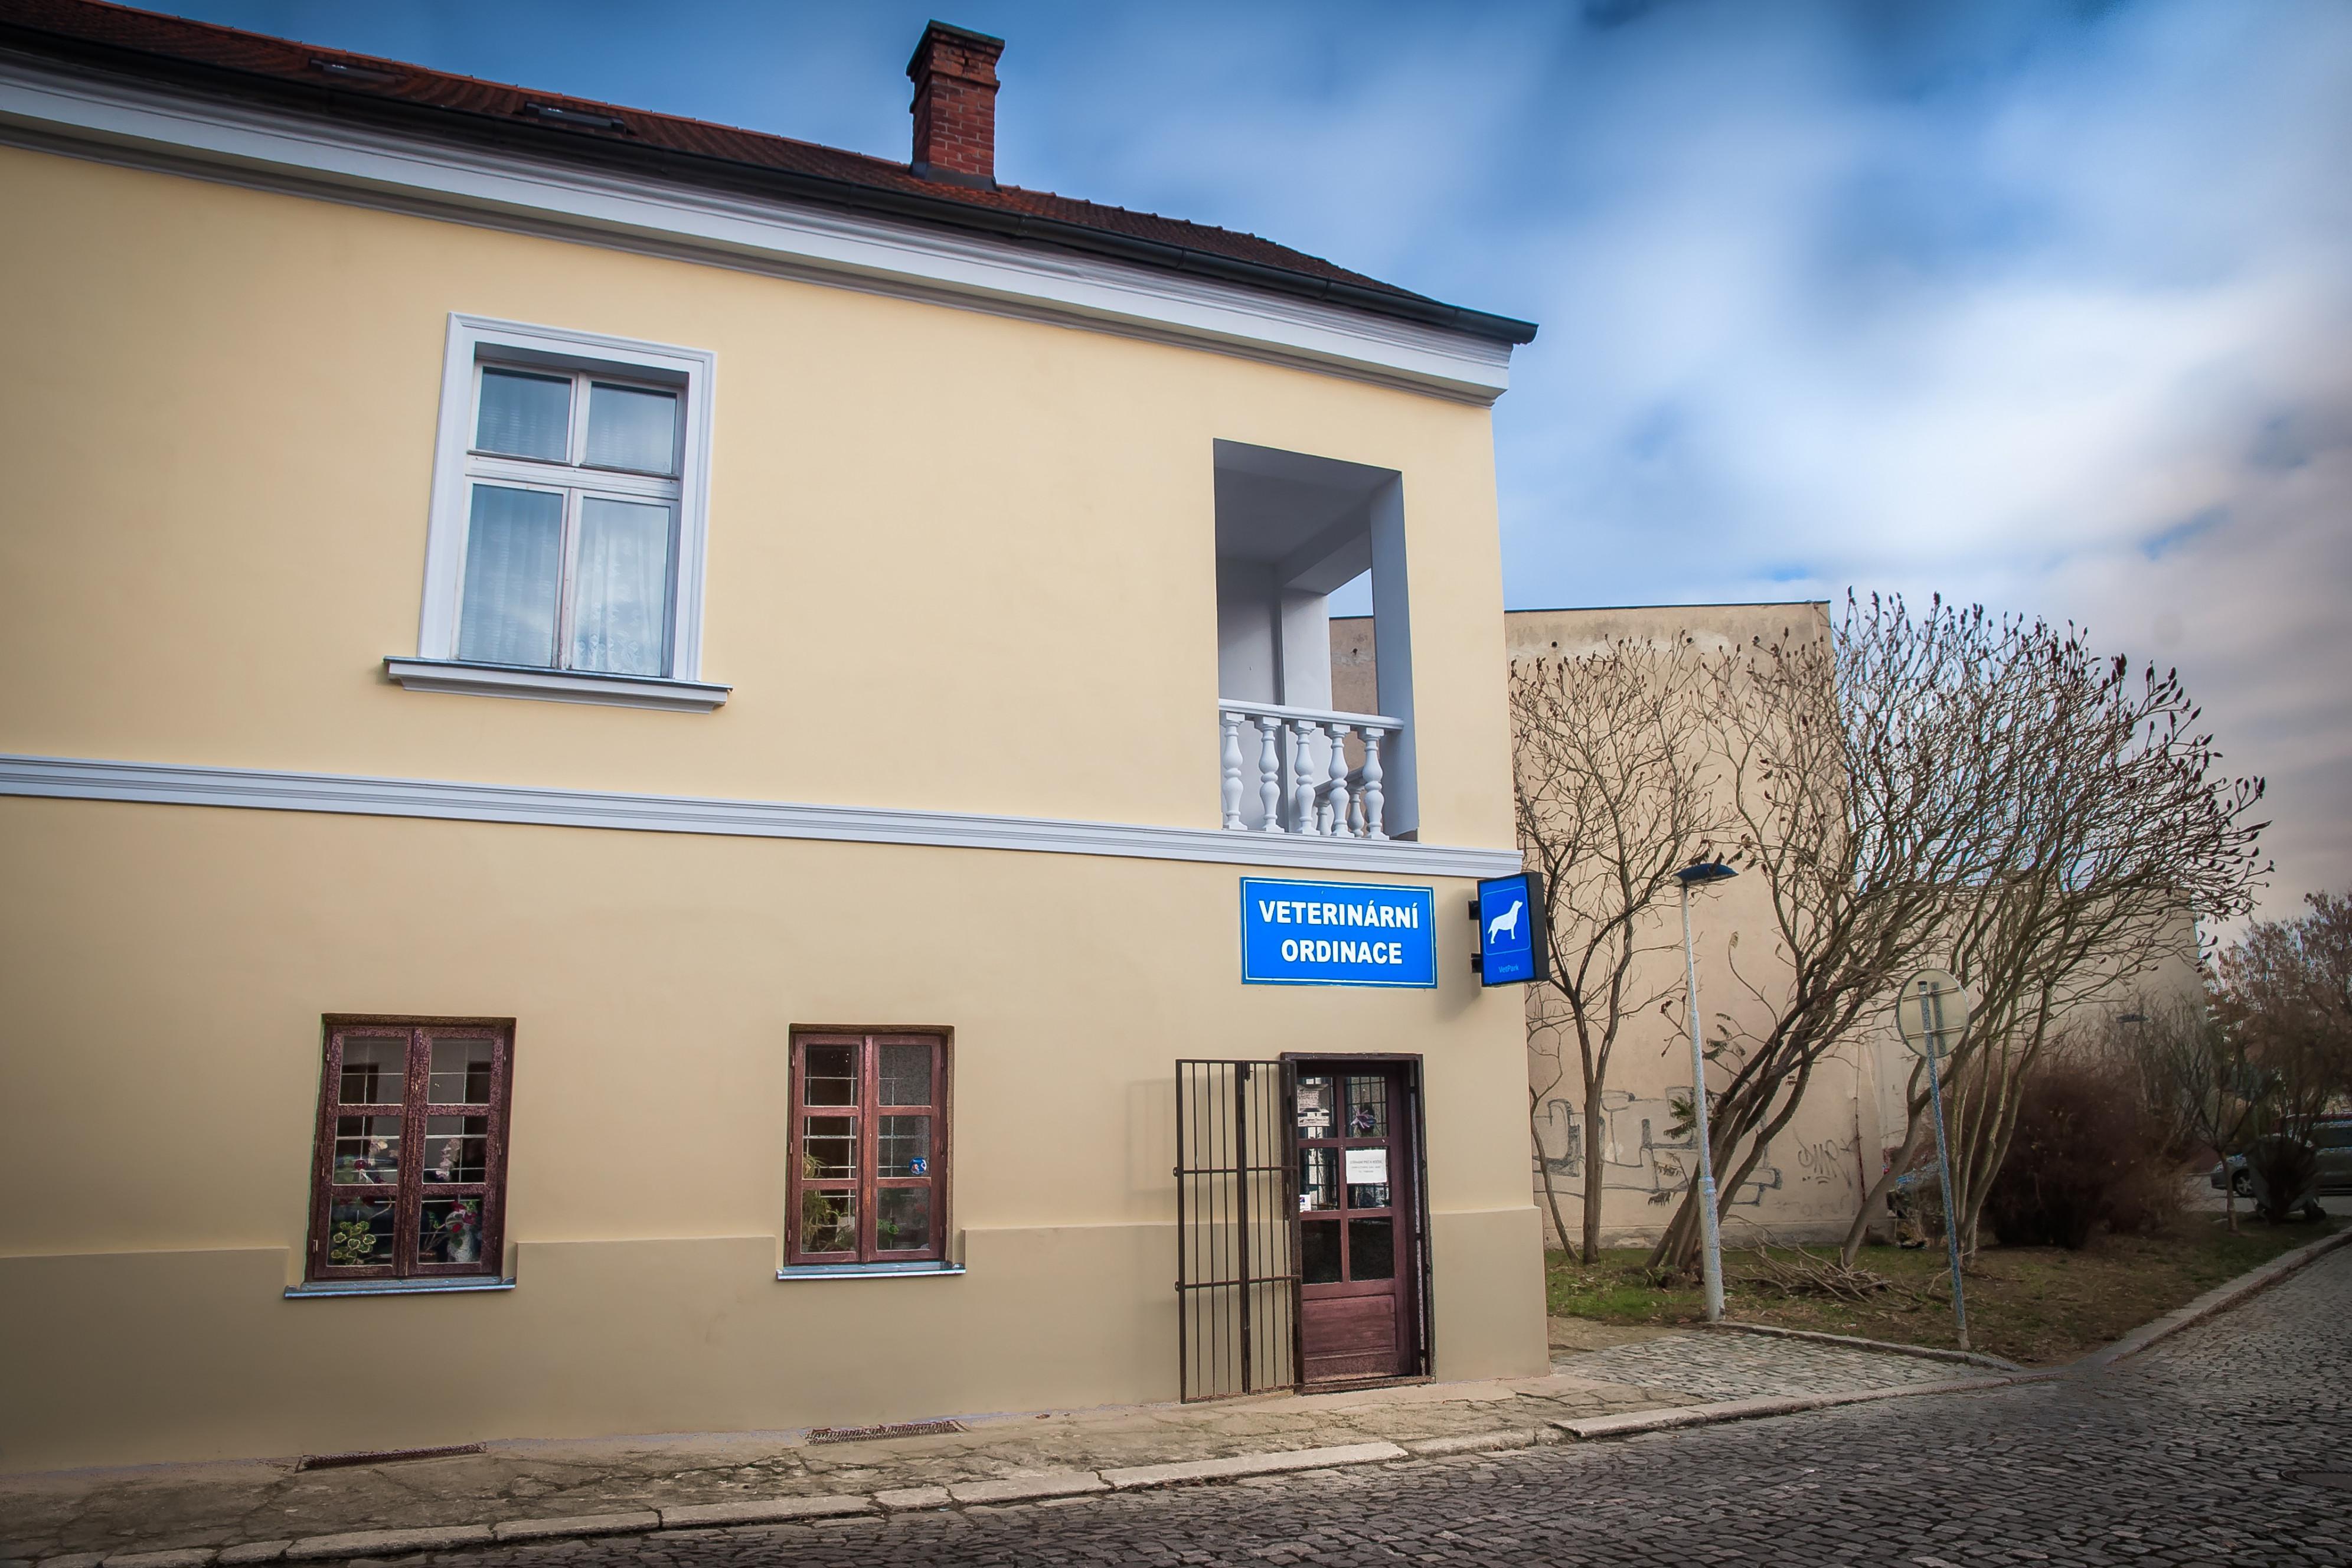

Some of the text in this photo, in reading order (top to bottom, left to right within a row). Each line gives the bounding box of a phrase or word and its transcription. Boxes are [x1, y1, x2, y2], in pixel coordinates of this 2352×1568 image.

[1258, 900, 1419, 929] VETERINÁRNÍ
[1281, 939, 1403, 964] ORDINACE
[1498, 963, 1519, 973] VetPark
